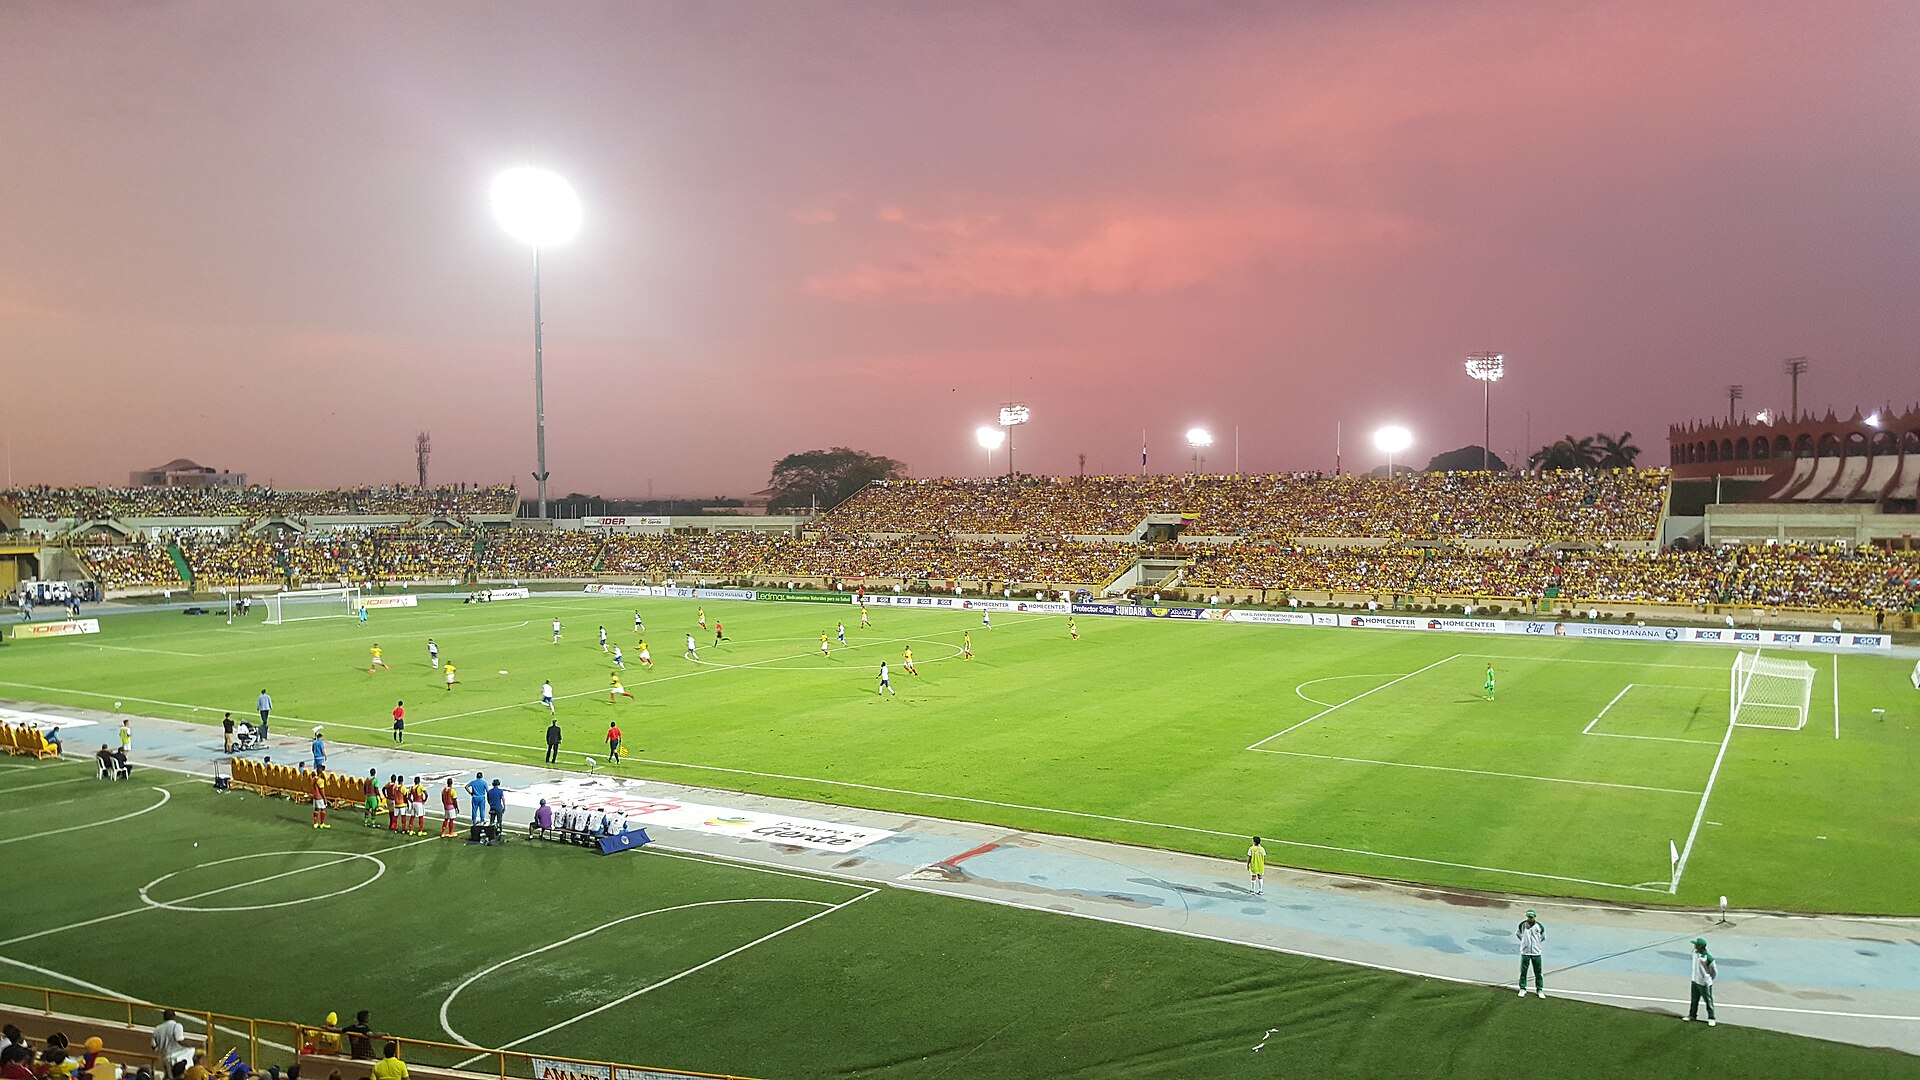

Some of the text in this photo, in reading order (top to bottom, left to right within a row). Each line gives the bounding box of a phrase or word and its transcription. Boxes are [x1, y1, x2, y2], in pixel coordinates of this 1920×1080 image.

[1072, 604, 1098, 613] Protector
[1099, 605, 1114, 614] Solar
[1115, 605, 1148, 617] SUNDARK
[1443, 620, 1496, 628] HOMECENTER
[1526, 622, 1546, 634] Elif
[1582, 627, 1620, 636] ESTRENO
[1702, 631, 1719, 640] GOL
[1740, 632, 1757, 641] GOL
[1780, 633, 1797, 642] GOL
[1820, 635, 1838, 644] GOL
[1859, 636, 1878, 645] GOL
[751, 826, 855, 847] Gente
